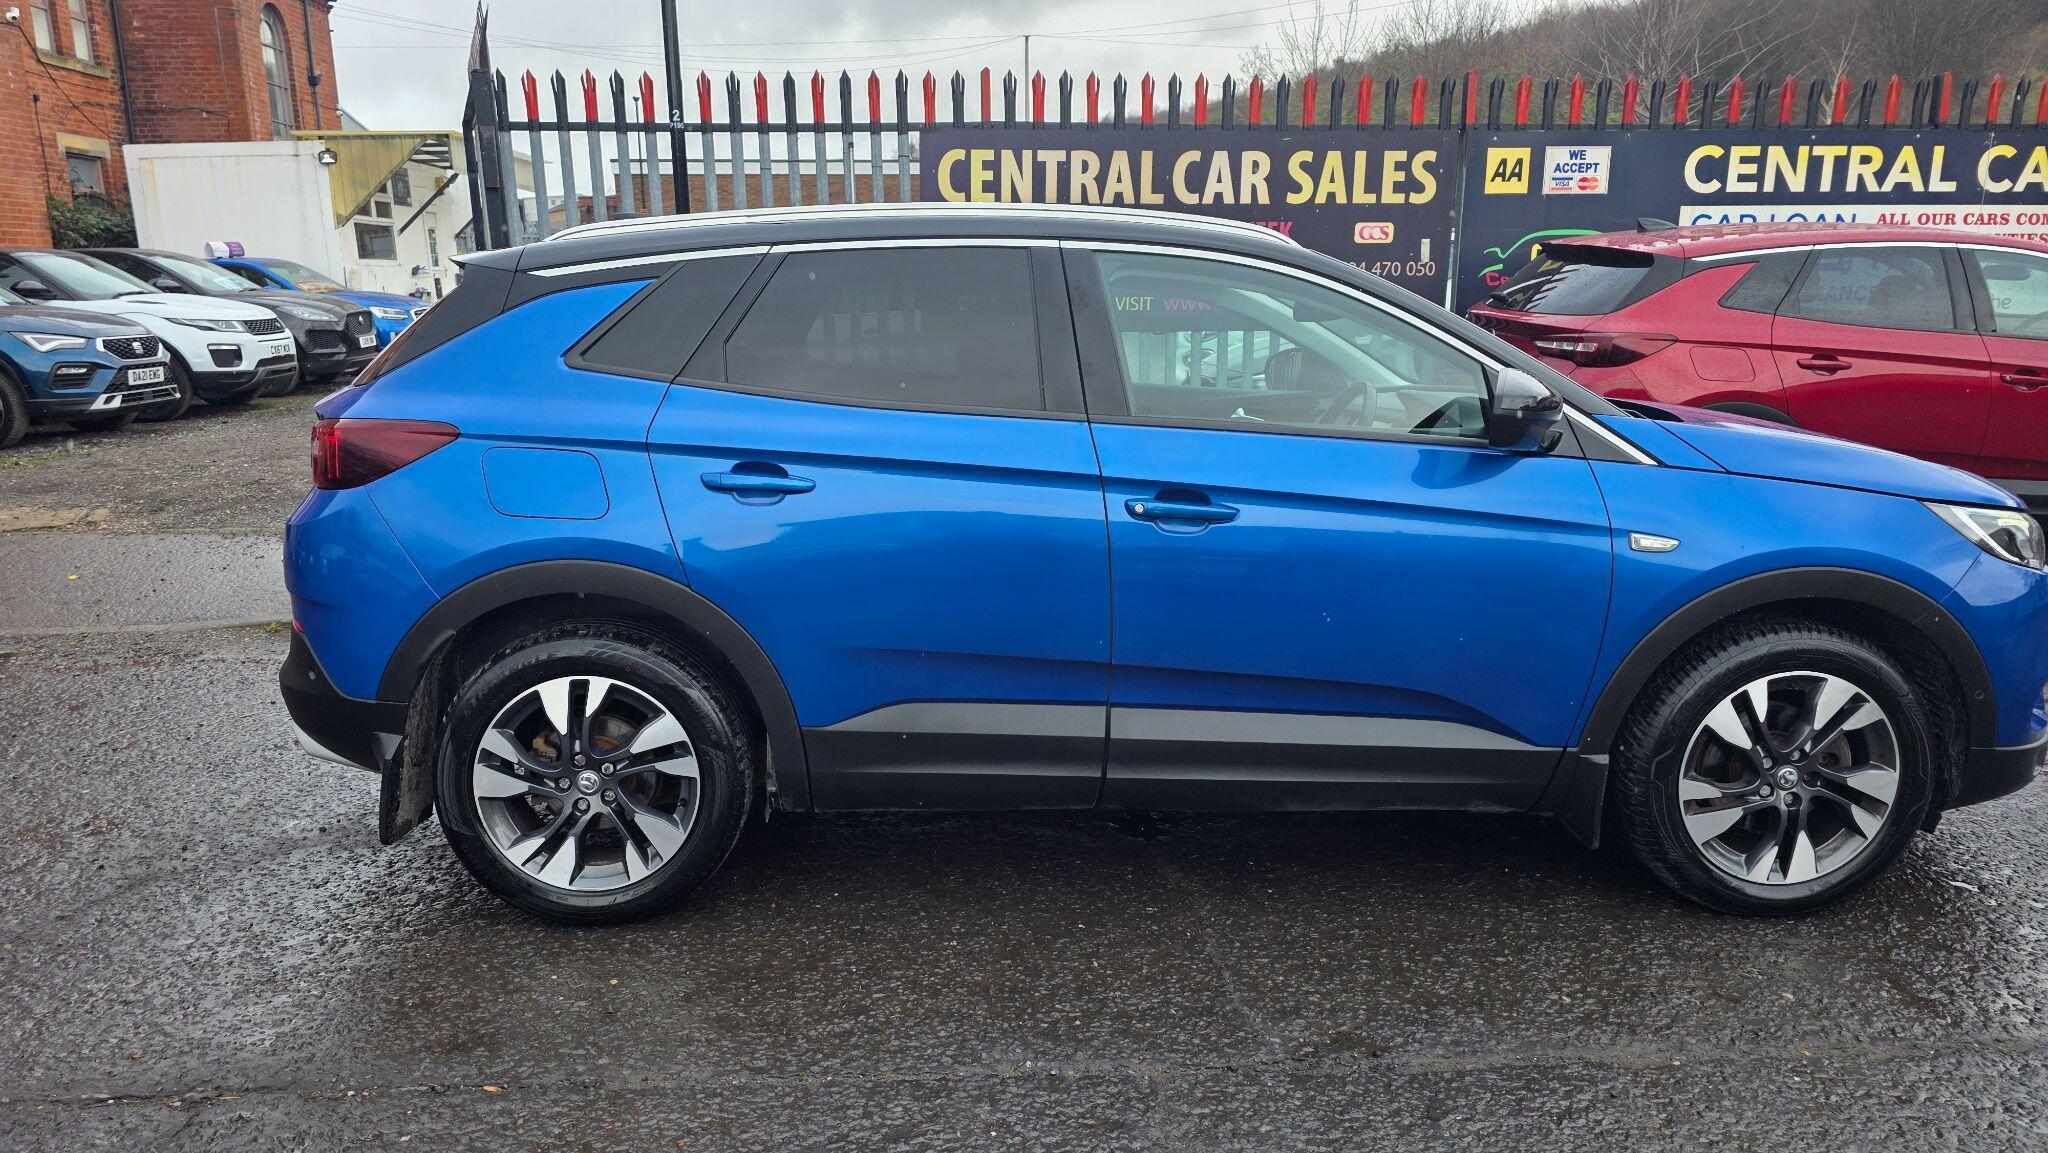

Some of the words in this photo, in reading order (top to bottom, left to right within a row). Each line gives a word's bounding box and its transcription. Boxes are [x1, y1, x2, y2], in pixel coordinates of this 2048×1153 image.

[1569, 150, 1587, 160] WE
[1490, 157, 1523, 183] AA
[1553, 162, 1600, 174] ACCEPT
[1684, 145, 1957, 193] CENTRAL
[1978, 144, 2048, 193] CA
[937, 148, 1164, 205] CENTRAL
[1172, 150, 1271, 205] CAR
[1287, 150, 1438, 204] SALES
[1877, 213, 1911, 226] ALL
[1917, 213, 1957, 226] OUR
[1963, 213, 2011, 226] CARS
[1371, 261, 1402, 276] 470
[1406, 261, 1436, 276] 050
[1115, 296, 1154, 312] VISIT
[132, 370, 148, 382] DA21
